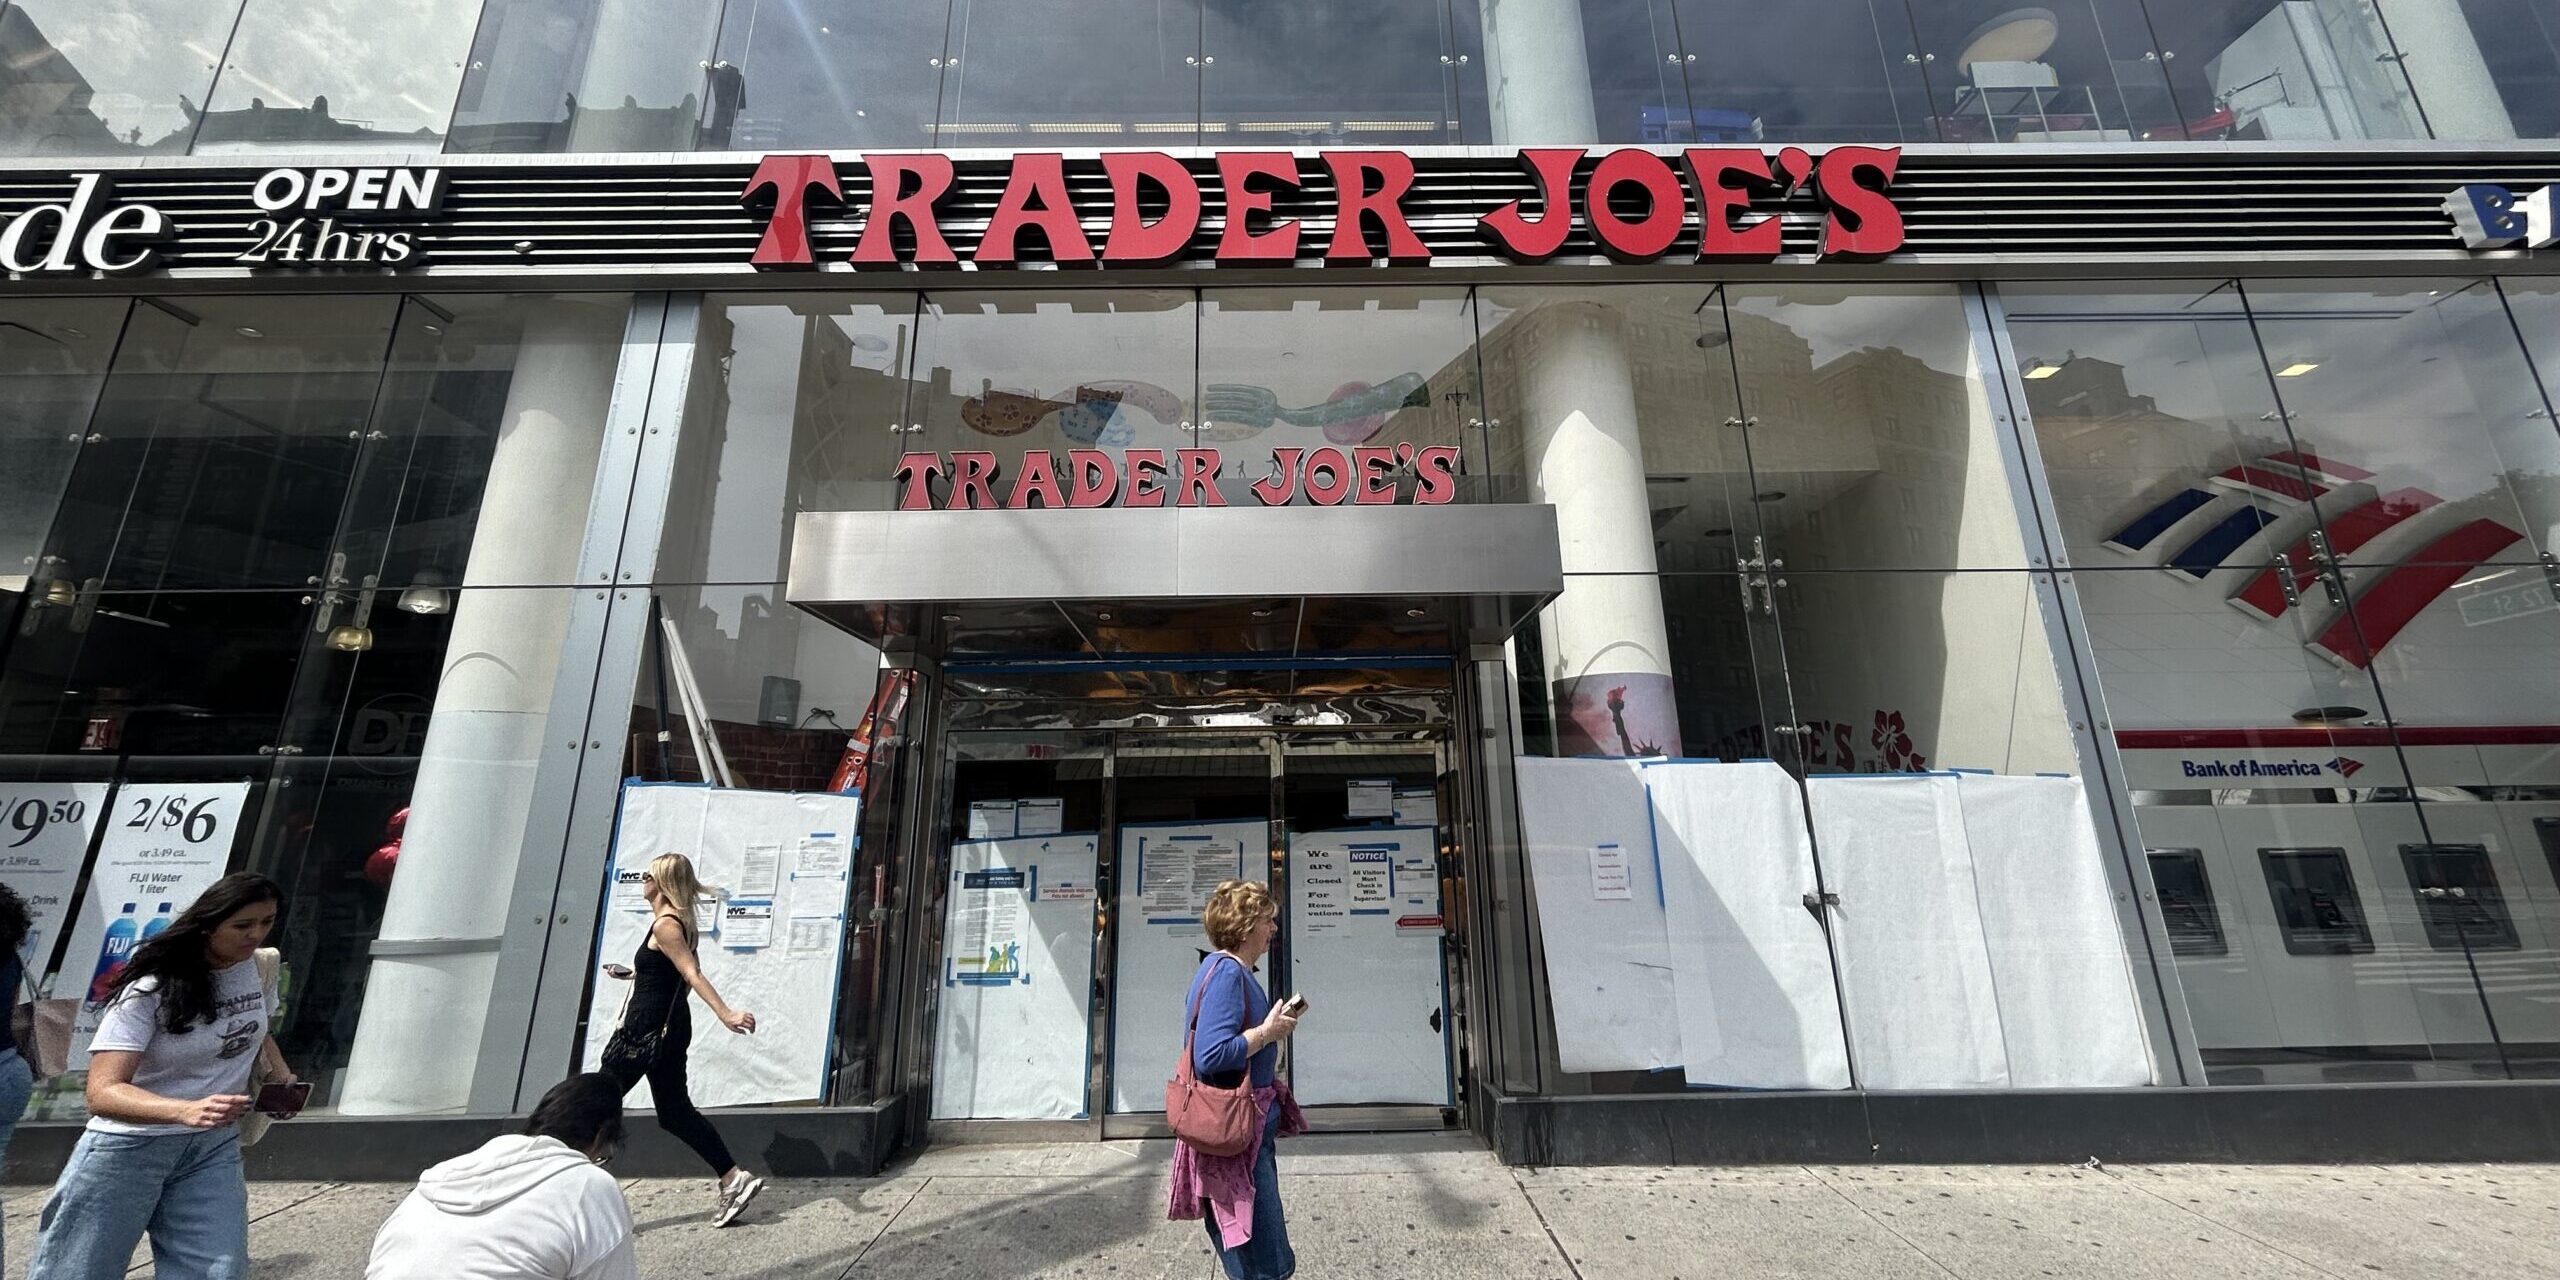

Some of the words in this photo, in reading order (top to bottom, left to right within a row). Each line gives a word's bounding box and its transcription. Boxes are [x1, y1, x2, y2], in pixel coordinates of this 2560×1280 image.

[251, 168, 441, 211] OPEN
[740, 151, 1432, 265] TRADER
[1477, 146, 1905, 259] JOE'S
[237, 219, 412, 264] 24hrs
[894, 447, 1229, 511] TRADER
[1250, 442, 1462, 507] JOE'S
[2182, 760, 2230, 777] Bank
[2229, 760, 2247, 777] of
[2250, 760, 2321, 776] America
[126, 793, 220, 843] 2/$6
[1307, 850, 1329, 858] We
[1351, 852, 1386, 860] NOTICE
[130, 873, 150, 883] FIJI
[151, 873, 183, 883] Water
[620, 872, 641, 881] NYC
[139, 884, 145, 894] 1
[146, 884, 167, 894] liter
[727, 907, 746, 916] NYC
[106, 937, 131, 954] FIJI
